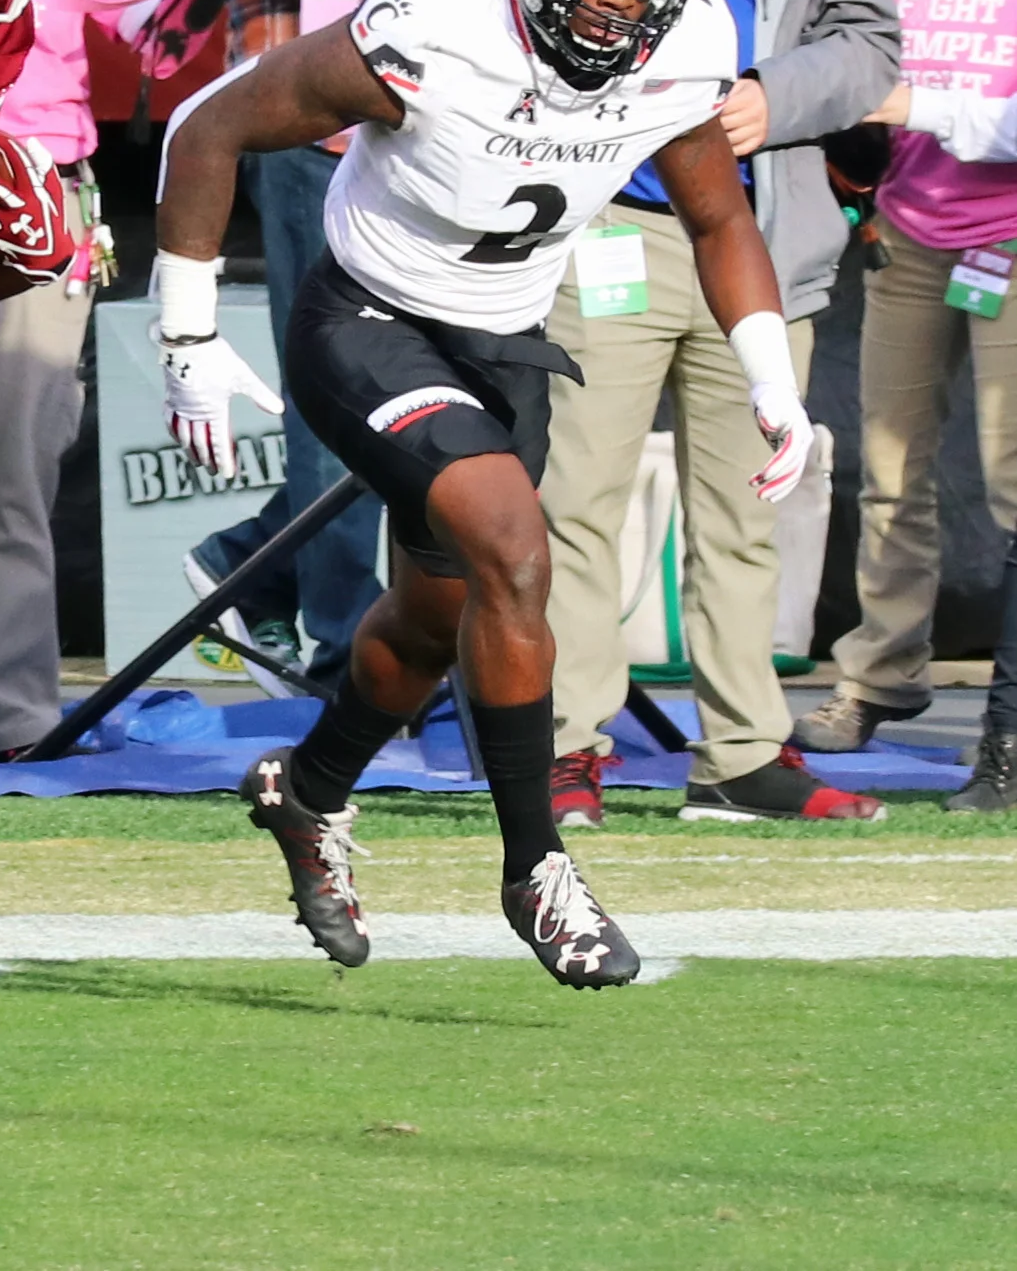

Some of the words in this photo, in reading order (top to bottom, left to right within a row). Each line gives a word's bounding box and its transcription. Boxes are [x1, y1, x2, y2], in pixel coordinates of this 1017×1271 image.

[900, 29, 1017, 67] EMPLE
[485, 134, 624, 164] CINCINNATI
[458, 183, 567, 264] 2
[124, 434, 288, 505] BEAR
